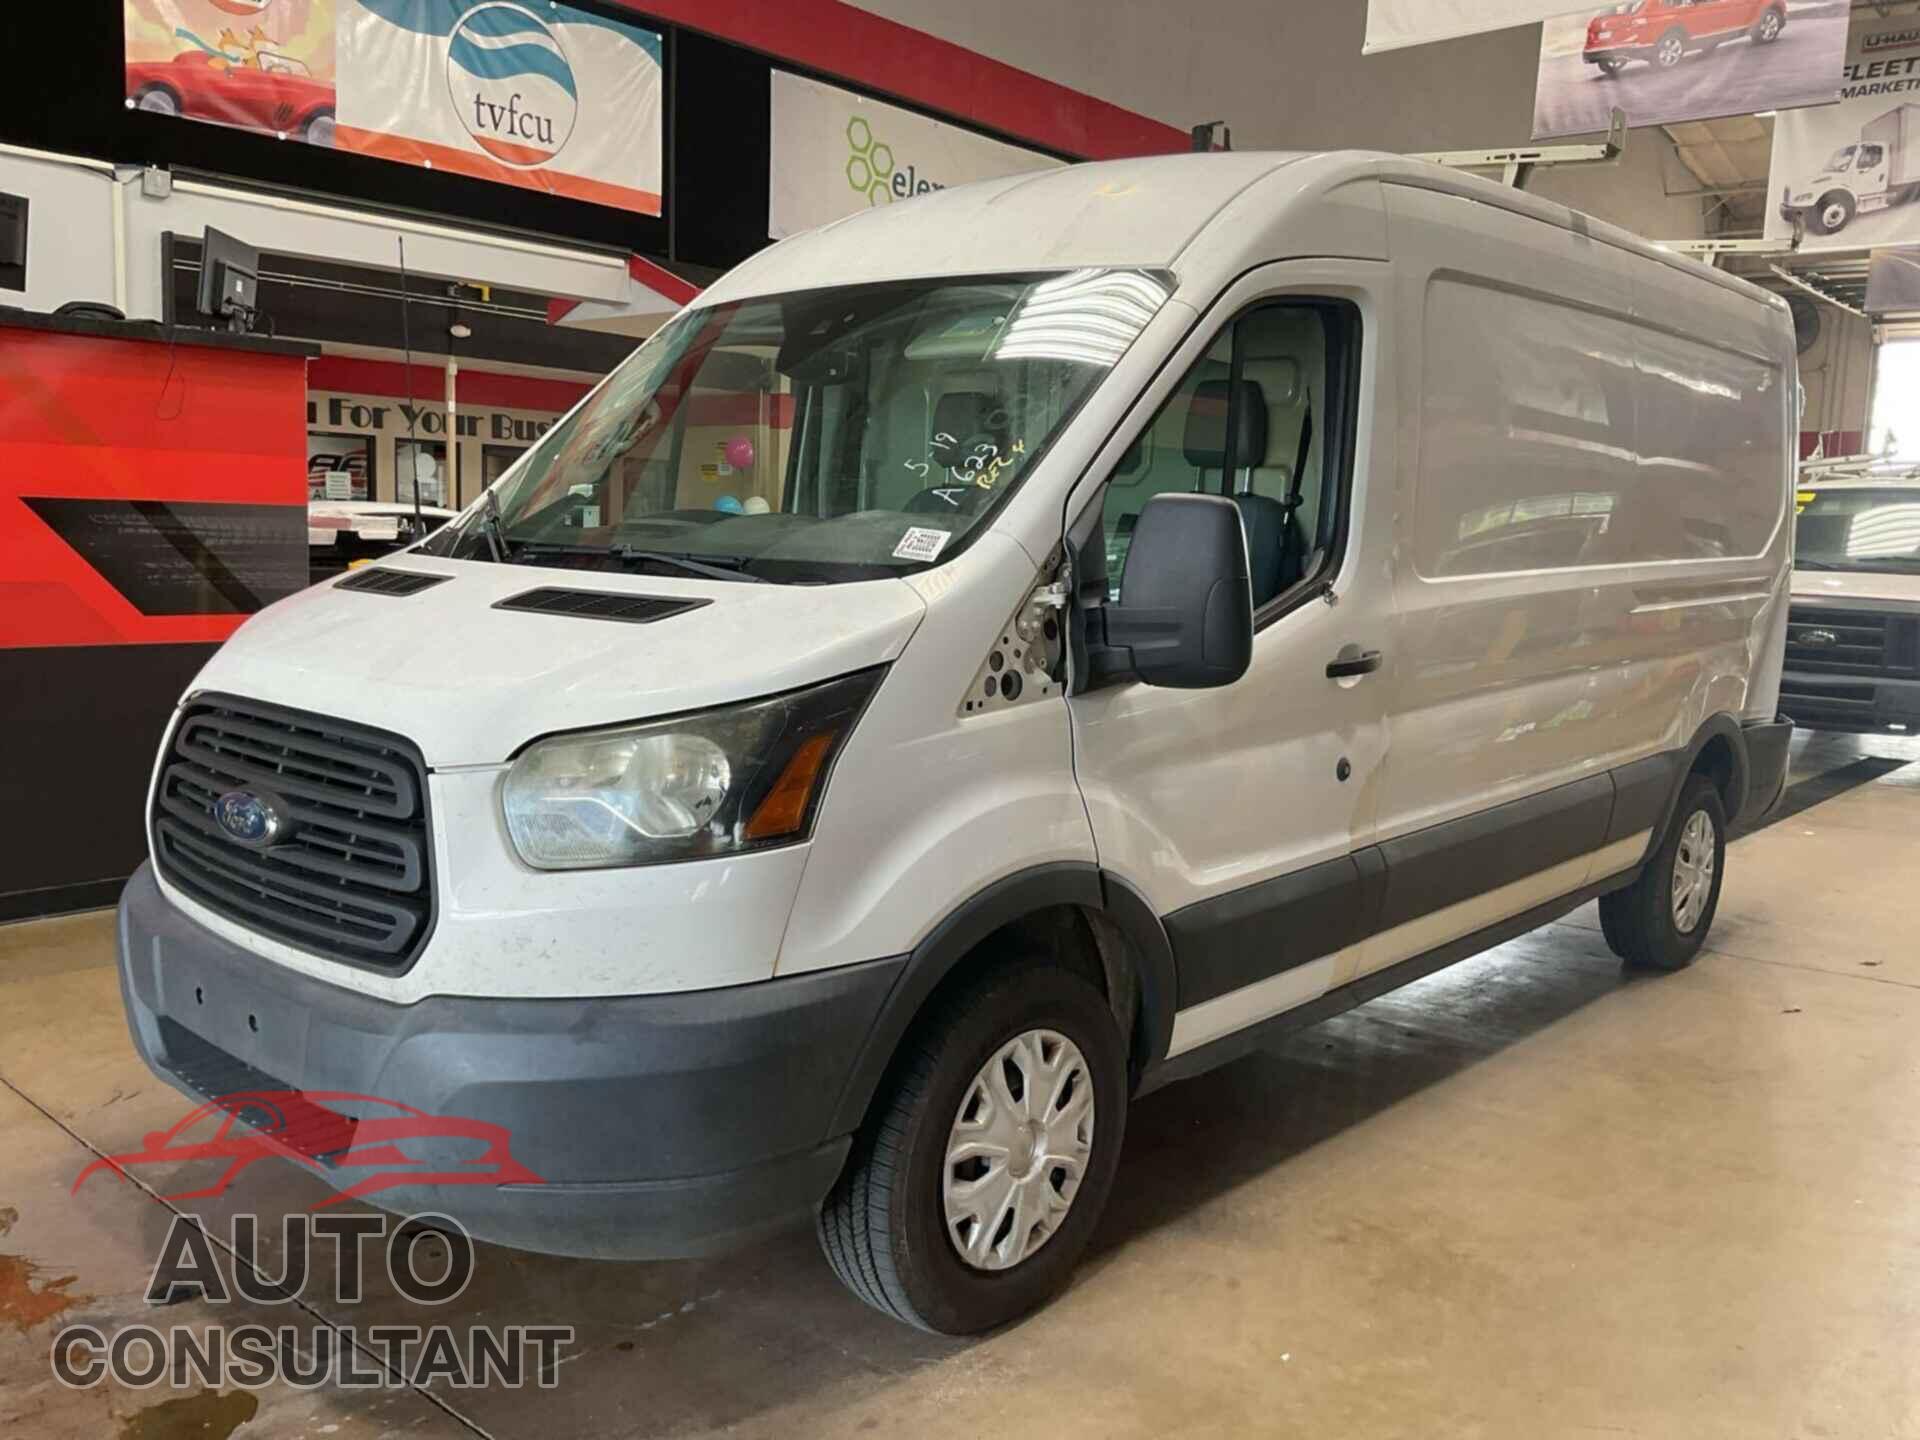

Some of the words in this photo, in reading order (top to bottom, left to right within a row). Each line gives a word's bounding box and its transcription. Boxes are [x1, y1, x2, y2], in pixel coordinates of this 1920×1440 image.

[474, 93, 554, 144] tvfcu
[329, 398, 392, 429] For
[398, 403, 485, 437] Your
